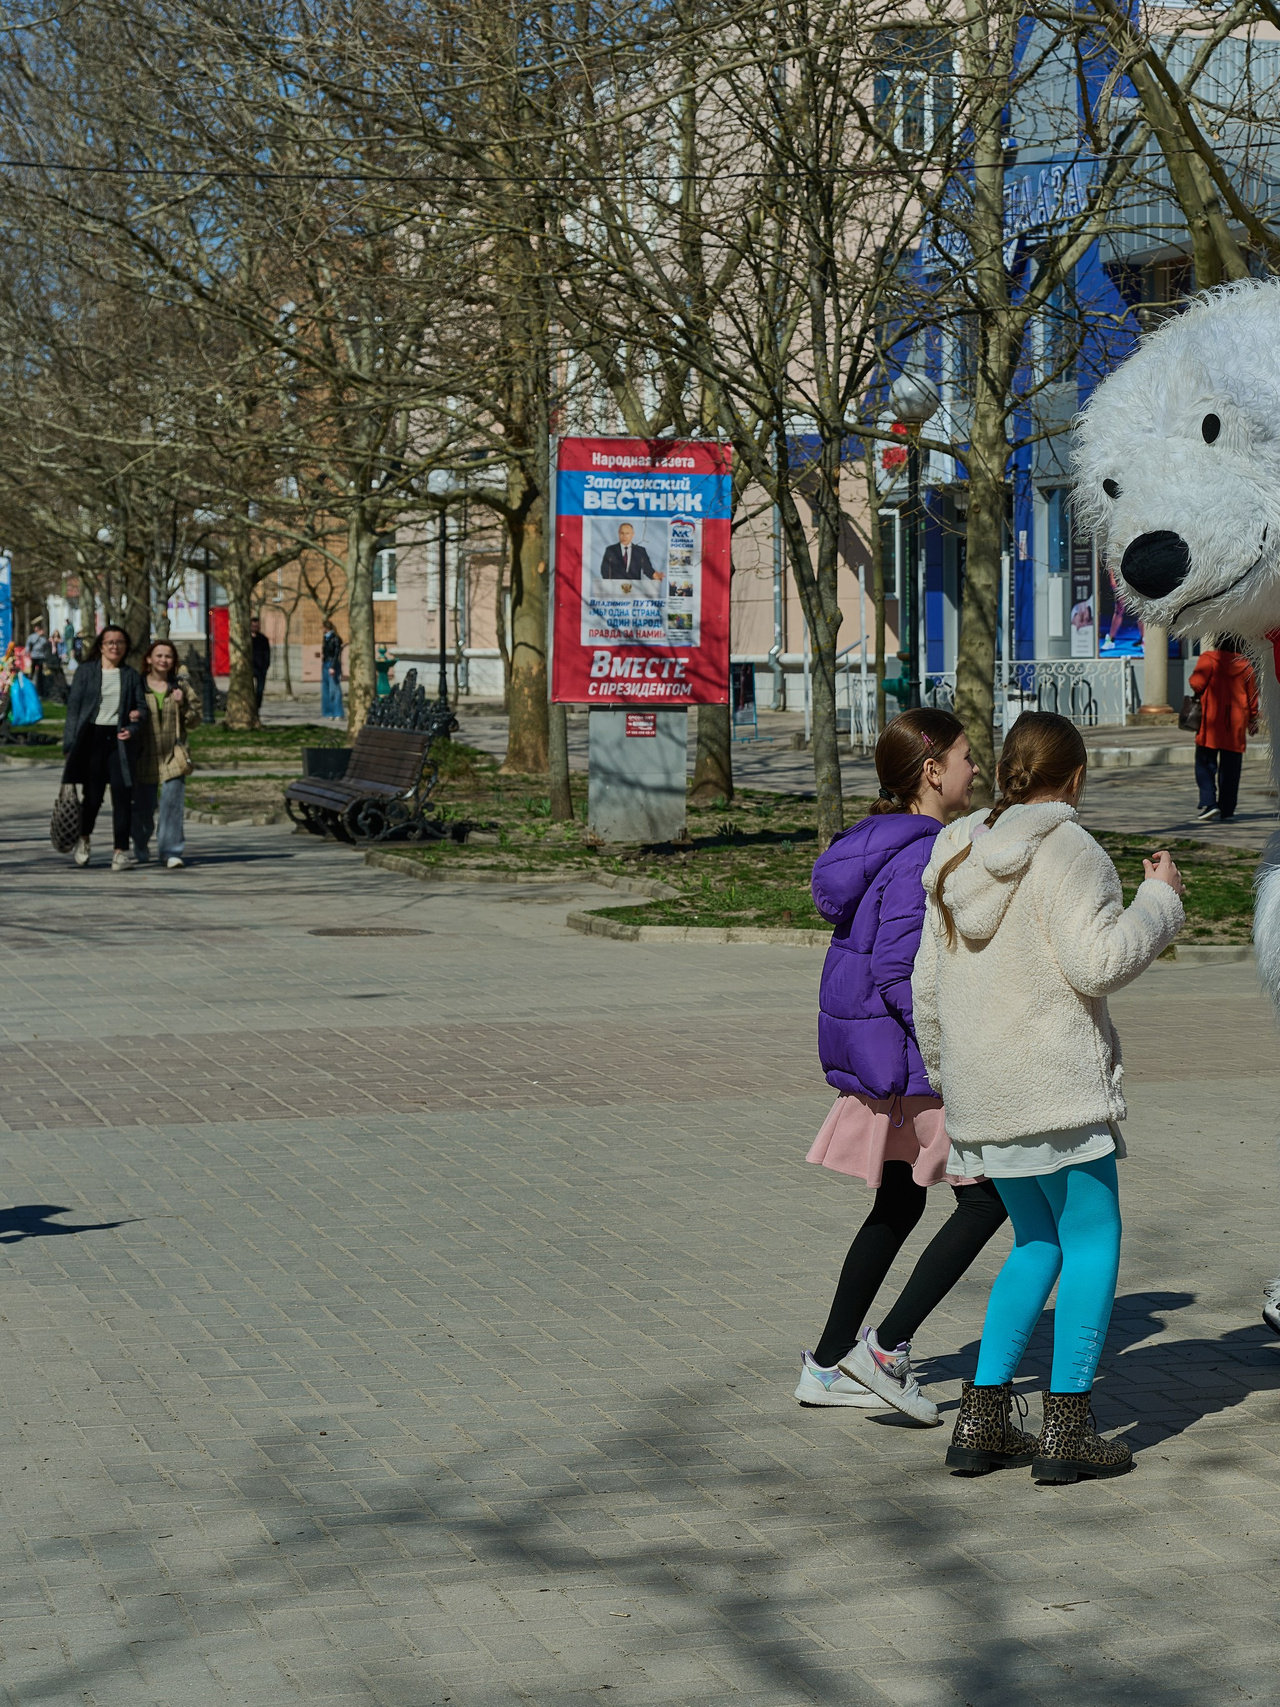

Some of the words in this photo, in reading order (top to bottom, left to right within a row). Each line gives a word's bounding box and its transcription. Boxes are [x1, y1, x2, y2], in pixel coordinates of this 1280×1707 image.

[592, 452, 652, 468] Народная
[655, 456, 695, 468] газета
[584, 475, 691, 492] Запорожский
[584, 491, 703, 512] ВЕСТНИК
[589, 608, 607, 616] «МЫ
[608, 608, 630, 617] ОДНА
[607, 619, 630, 628] ОДИН
[589, 629, 621, 638] ПРАВДА
[623, 629, 634, 637] ЗА
[588, 683, 598, 695] С
[599, 683, 692, 697] ПРЕЗИДЕНТОМ
[1092, 1330, 1099, 1338] 1
[1088, 1340, 1097, 1350] 2
[1085, 1354, 1093, 1363] 3
[1081, 1365, 1089, 1373] 4
[1077, 1378, 1086, 1387] 5
